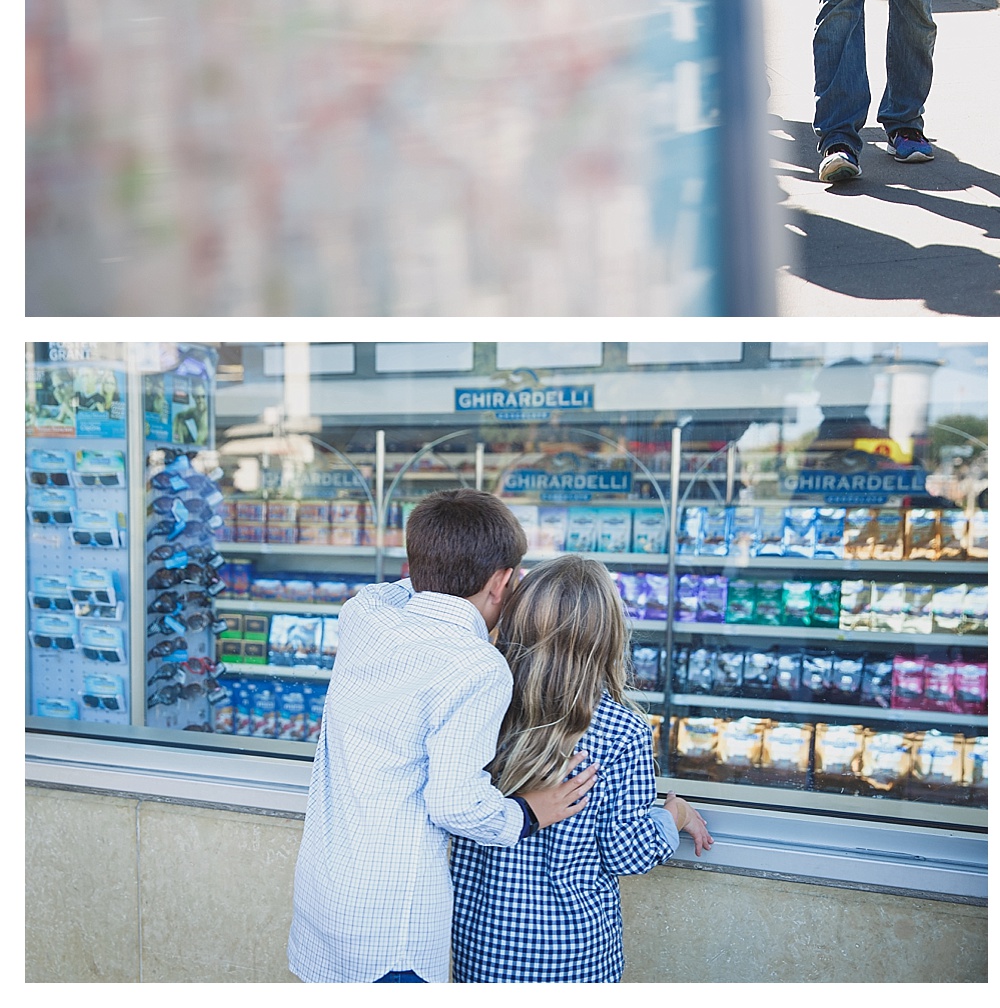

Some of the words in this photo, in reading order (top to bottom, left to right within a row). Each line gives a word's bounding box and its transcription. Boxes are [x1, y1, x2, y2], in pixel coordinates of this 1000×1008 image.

[458, 390, 589, 409] GHIRARDELLI
[505, 474, 628, 491] GHIRARDELLI
[784, 474, 924, 491] GHIRARDELL
